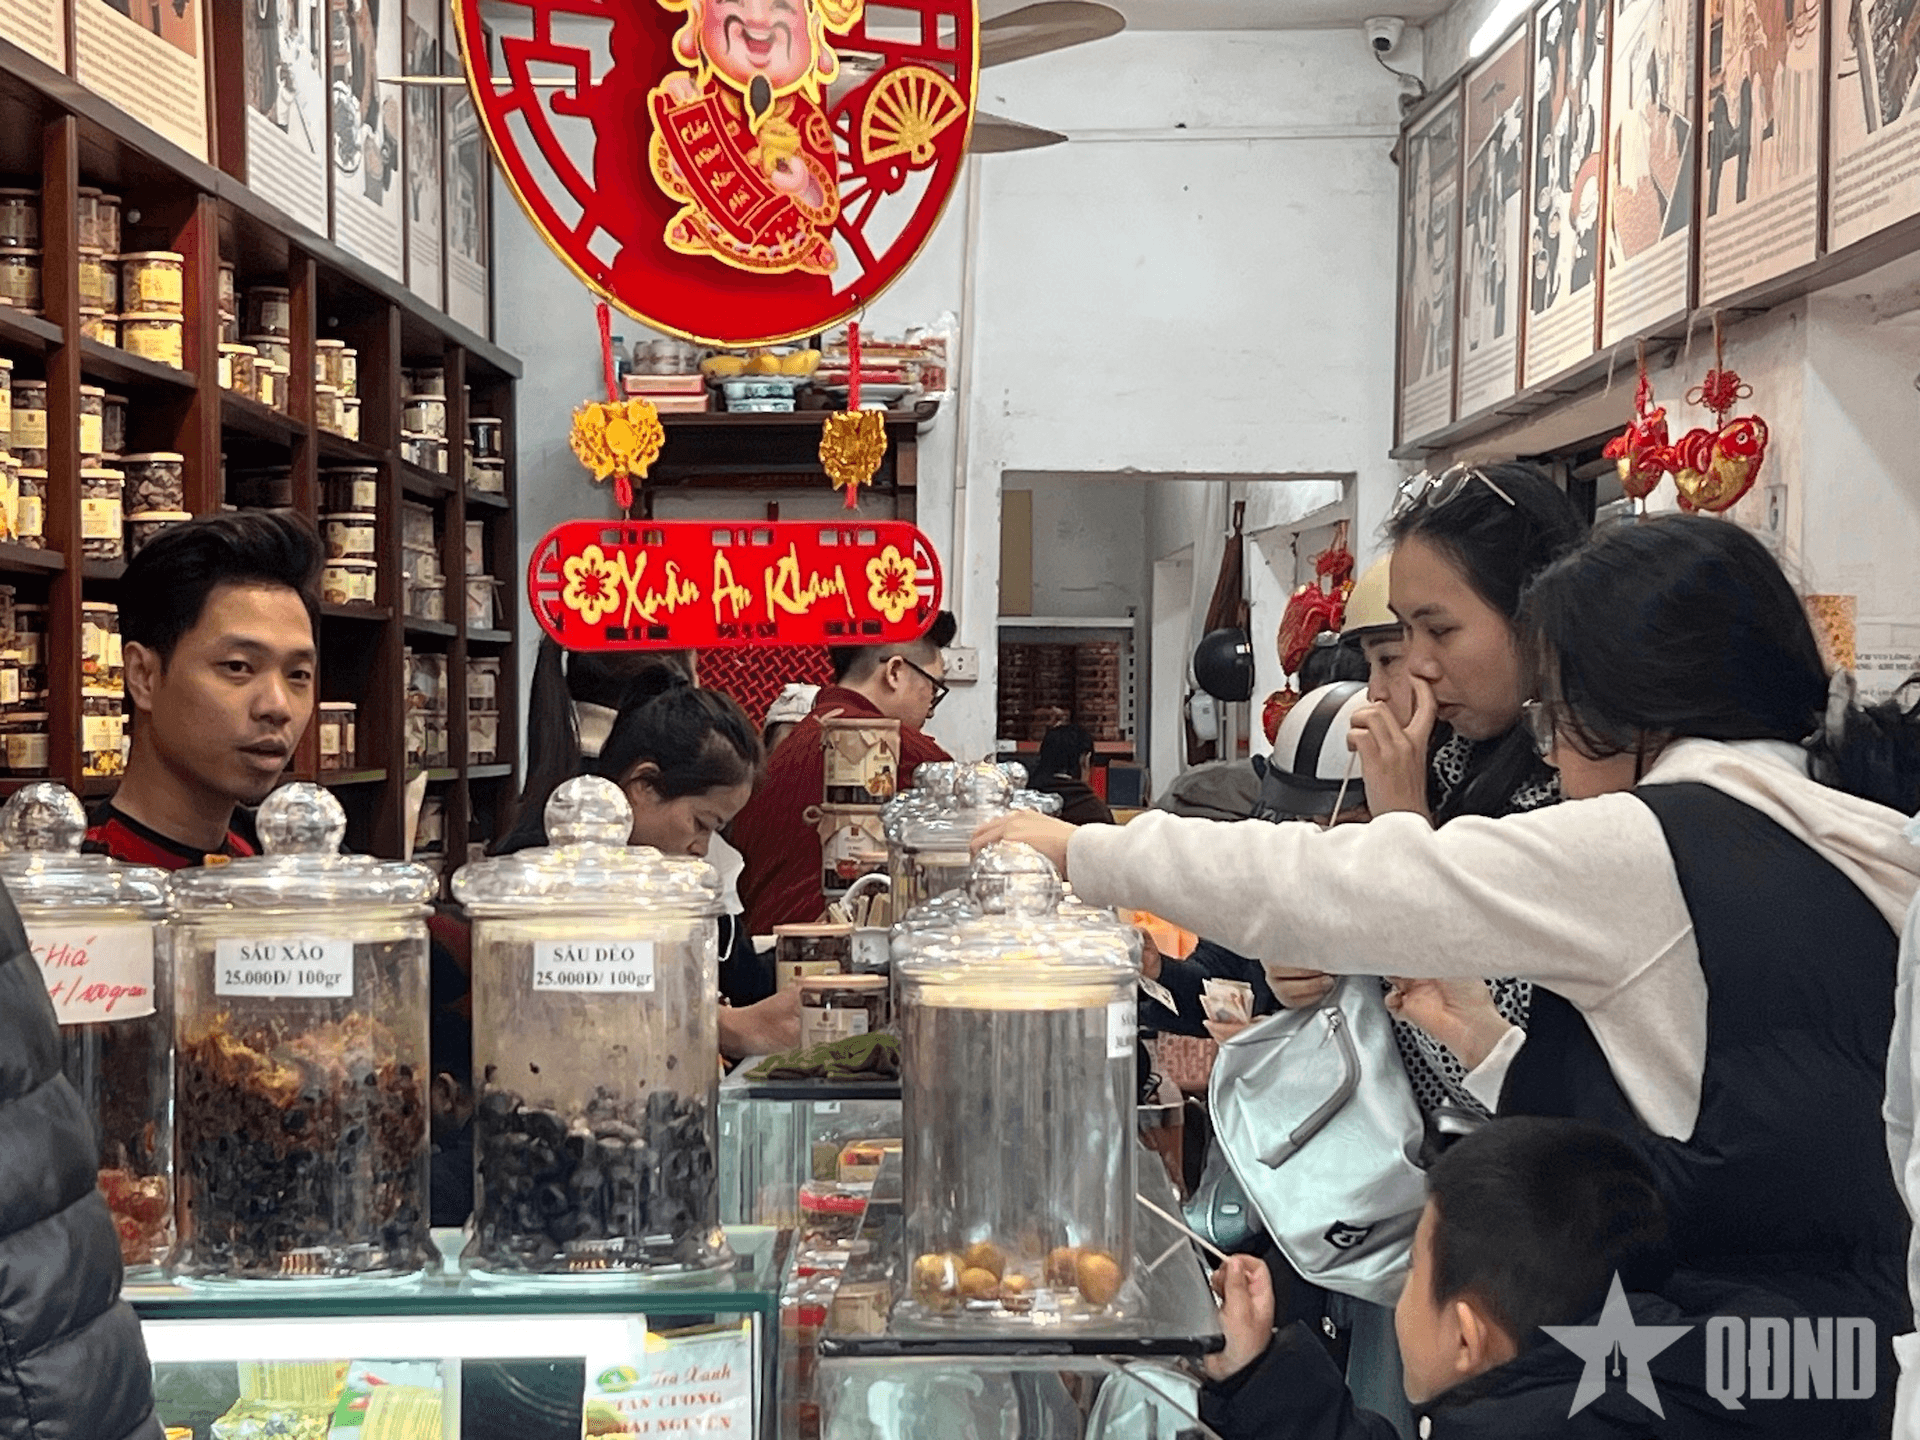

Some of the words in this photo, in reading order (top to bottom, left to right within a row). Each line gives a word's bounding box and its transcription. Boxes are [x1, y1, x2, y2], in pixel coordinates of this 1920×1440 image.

[617, 549, 700, 628] Xuân
[712, 548, 753, 625] An
[764, 541, 856, 623] Khang
[298, 969, 343, 989] 100gr
[610, 970, 652, 988] 100gr
